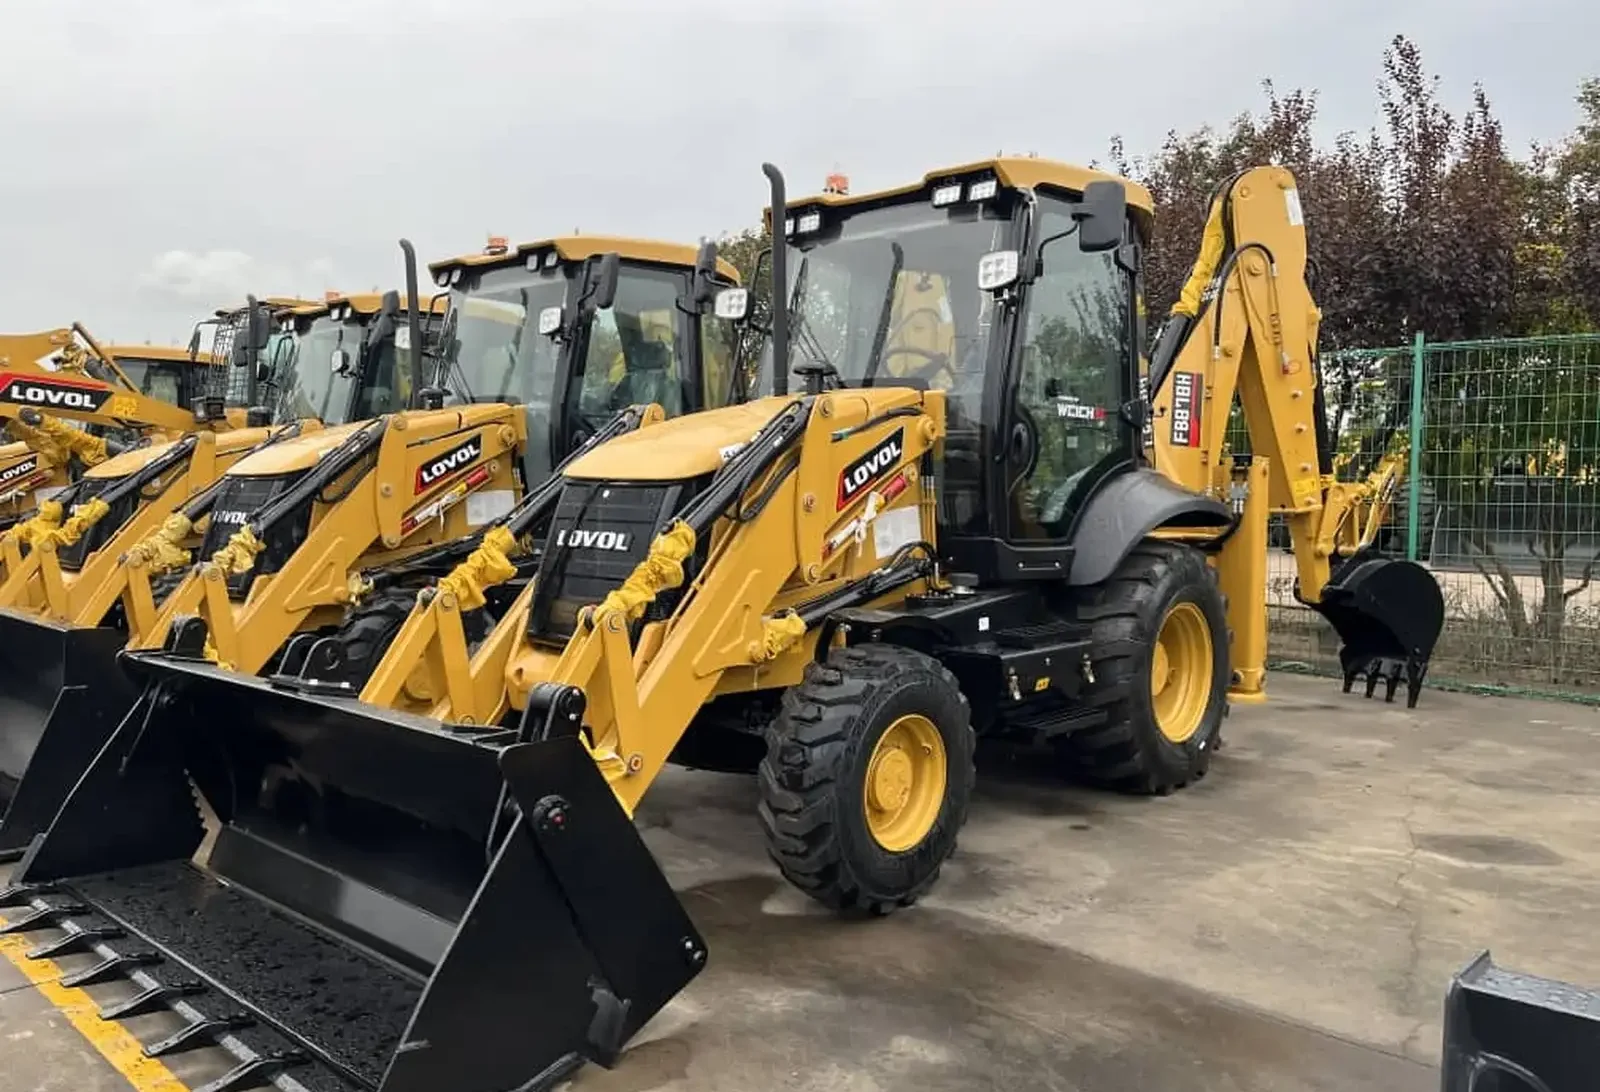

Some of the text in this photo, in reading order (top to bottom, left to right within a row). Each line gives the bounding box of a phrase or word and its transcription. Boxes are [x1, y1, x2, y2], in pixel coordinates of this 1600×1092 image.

[11, 385, 97, 408] LOVOL
[0, 461, 36, 482] OVOL
[422, 444, 480, 482] LOVOL
[844, 441, 901, 494] LOVOL
[556, 529, 628, 551] LOVOL
